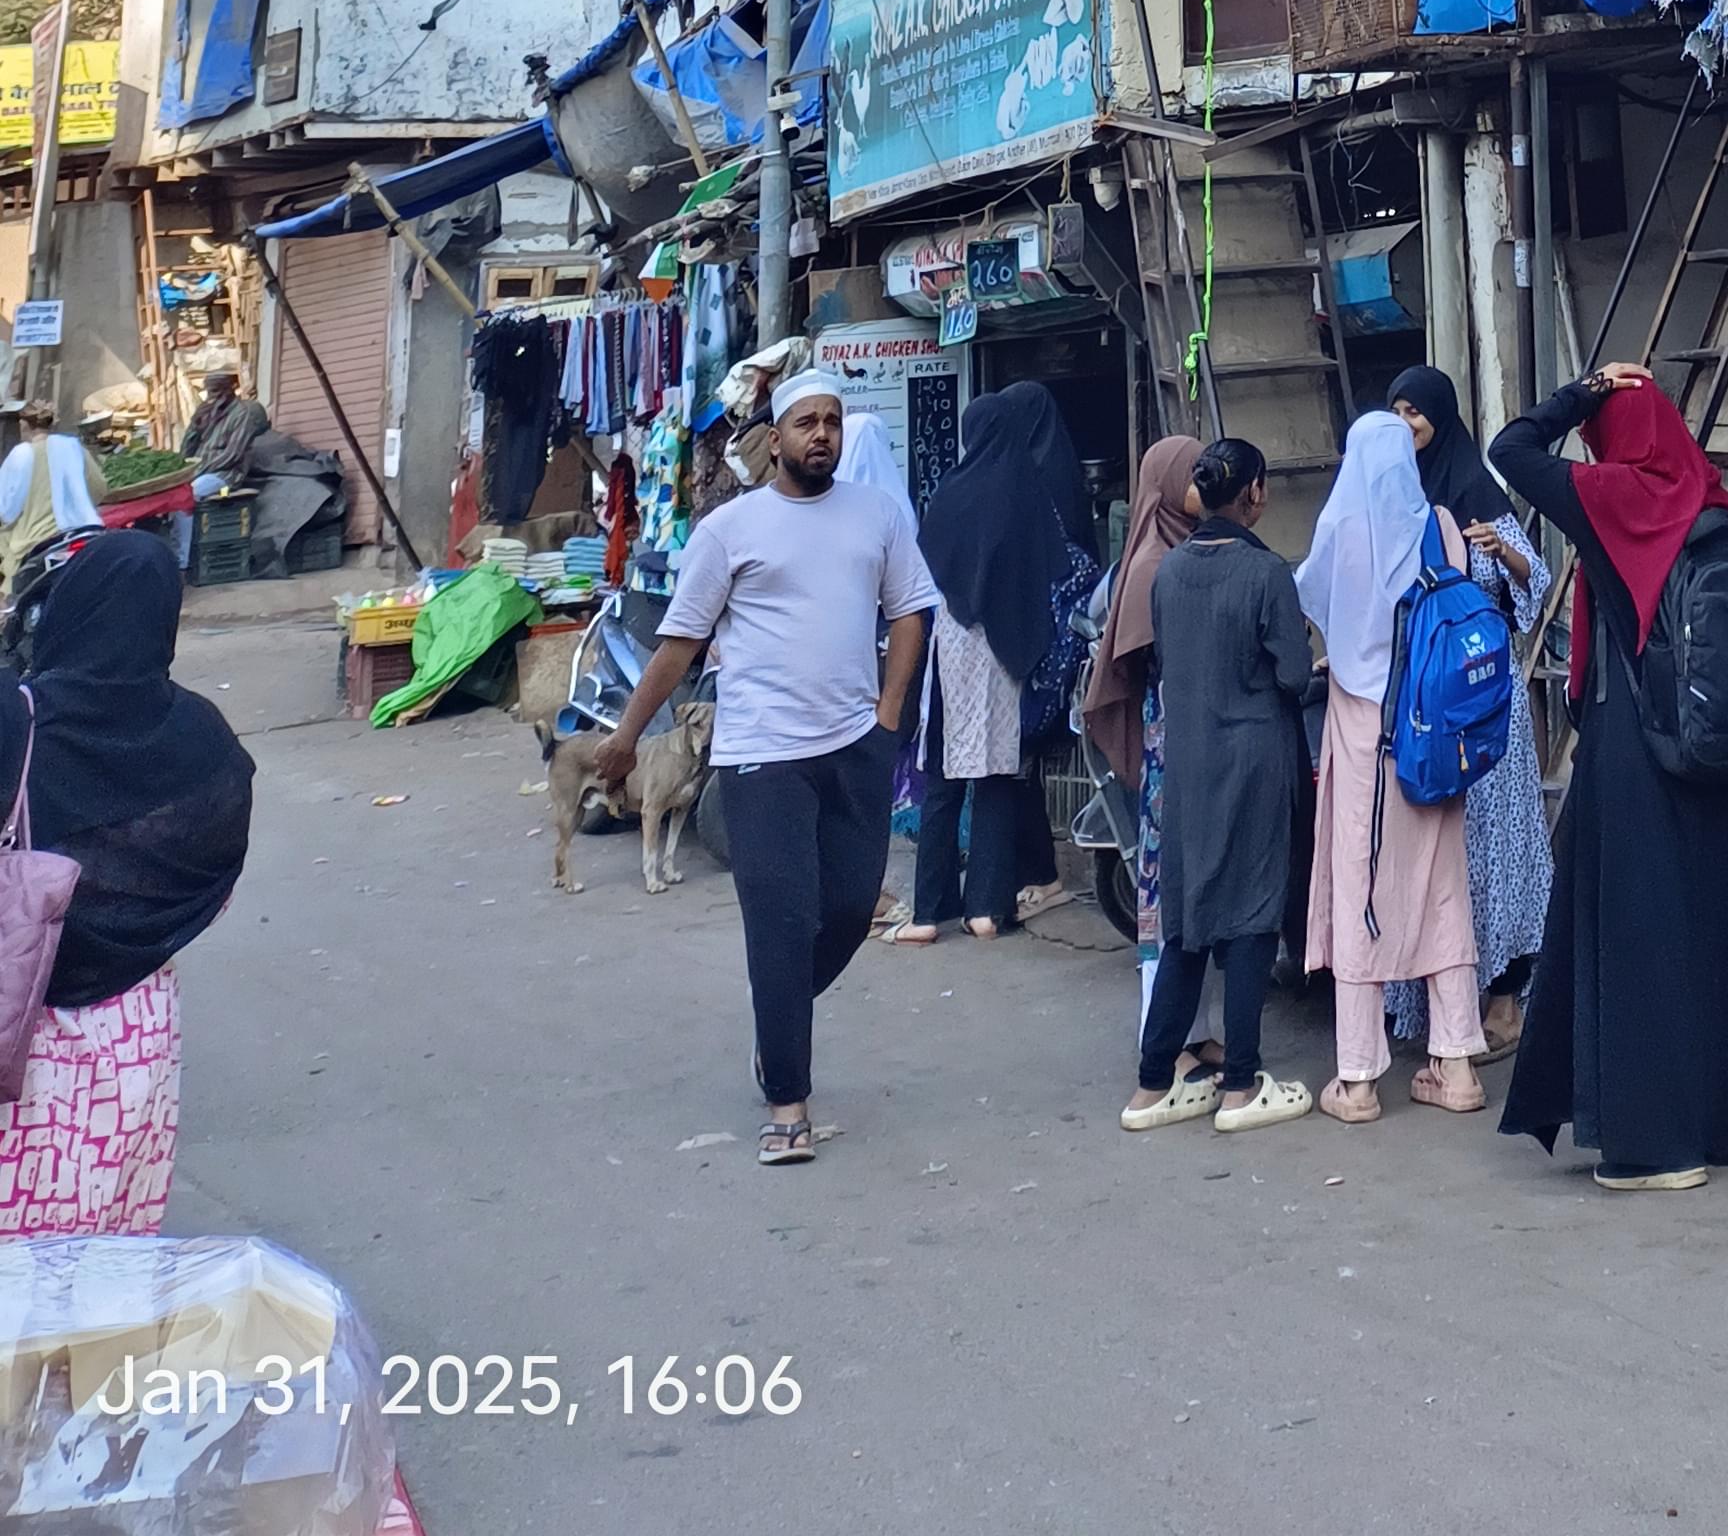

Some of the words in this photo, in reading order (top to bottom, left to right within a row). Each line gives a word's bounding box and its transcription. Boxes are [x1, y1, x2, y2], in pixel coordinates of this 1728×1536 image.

[972, 259, 1013, 293] 260
[948, 309, 974, 339] 160
[822, 344, 850, 361] RIYAZ
[853, 342, 872, 358] A.K.
[875, 339, 919, 358] CHICKEN
[921, 339, 944, 355] SHO
[914, 361, 950, 374] RATE
